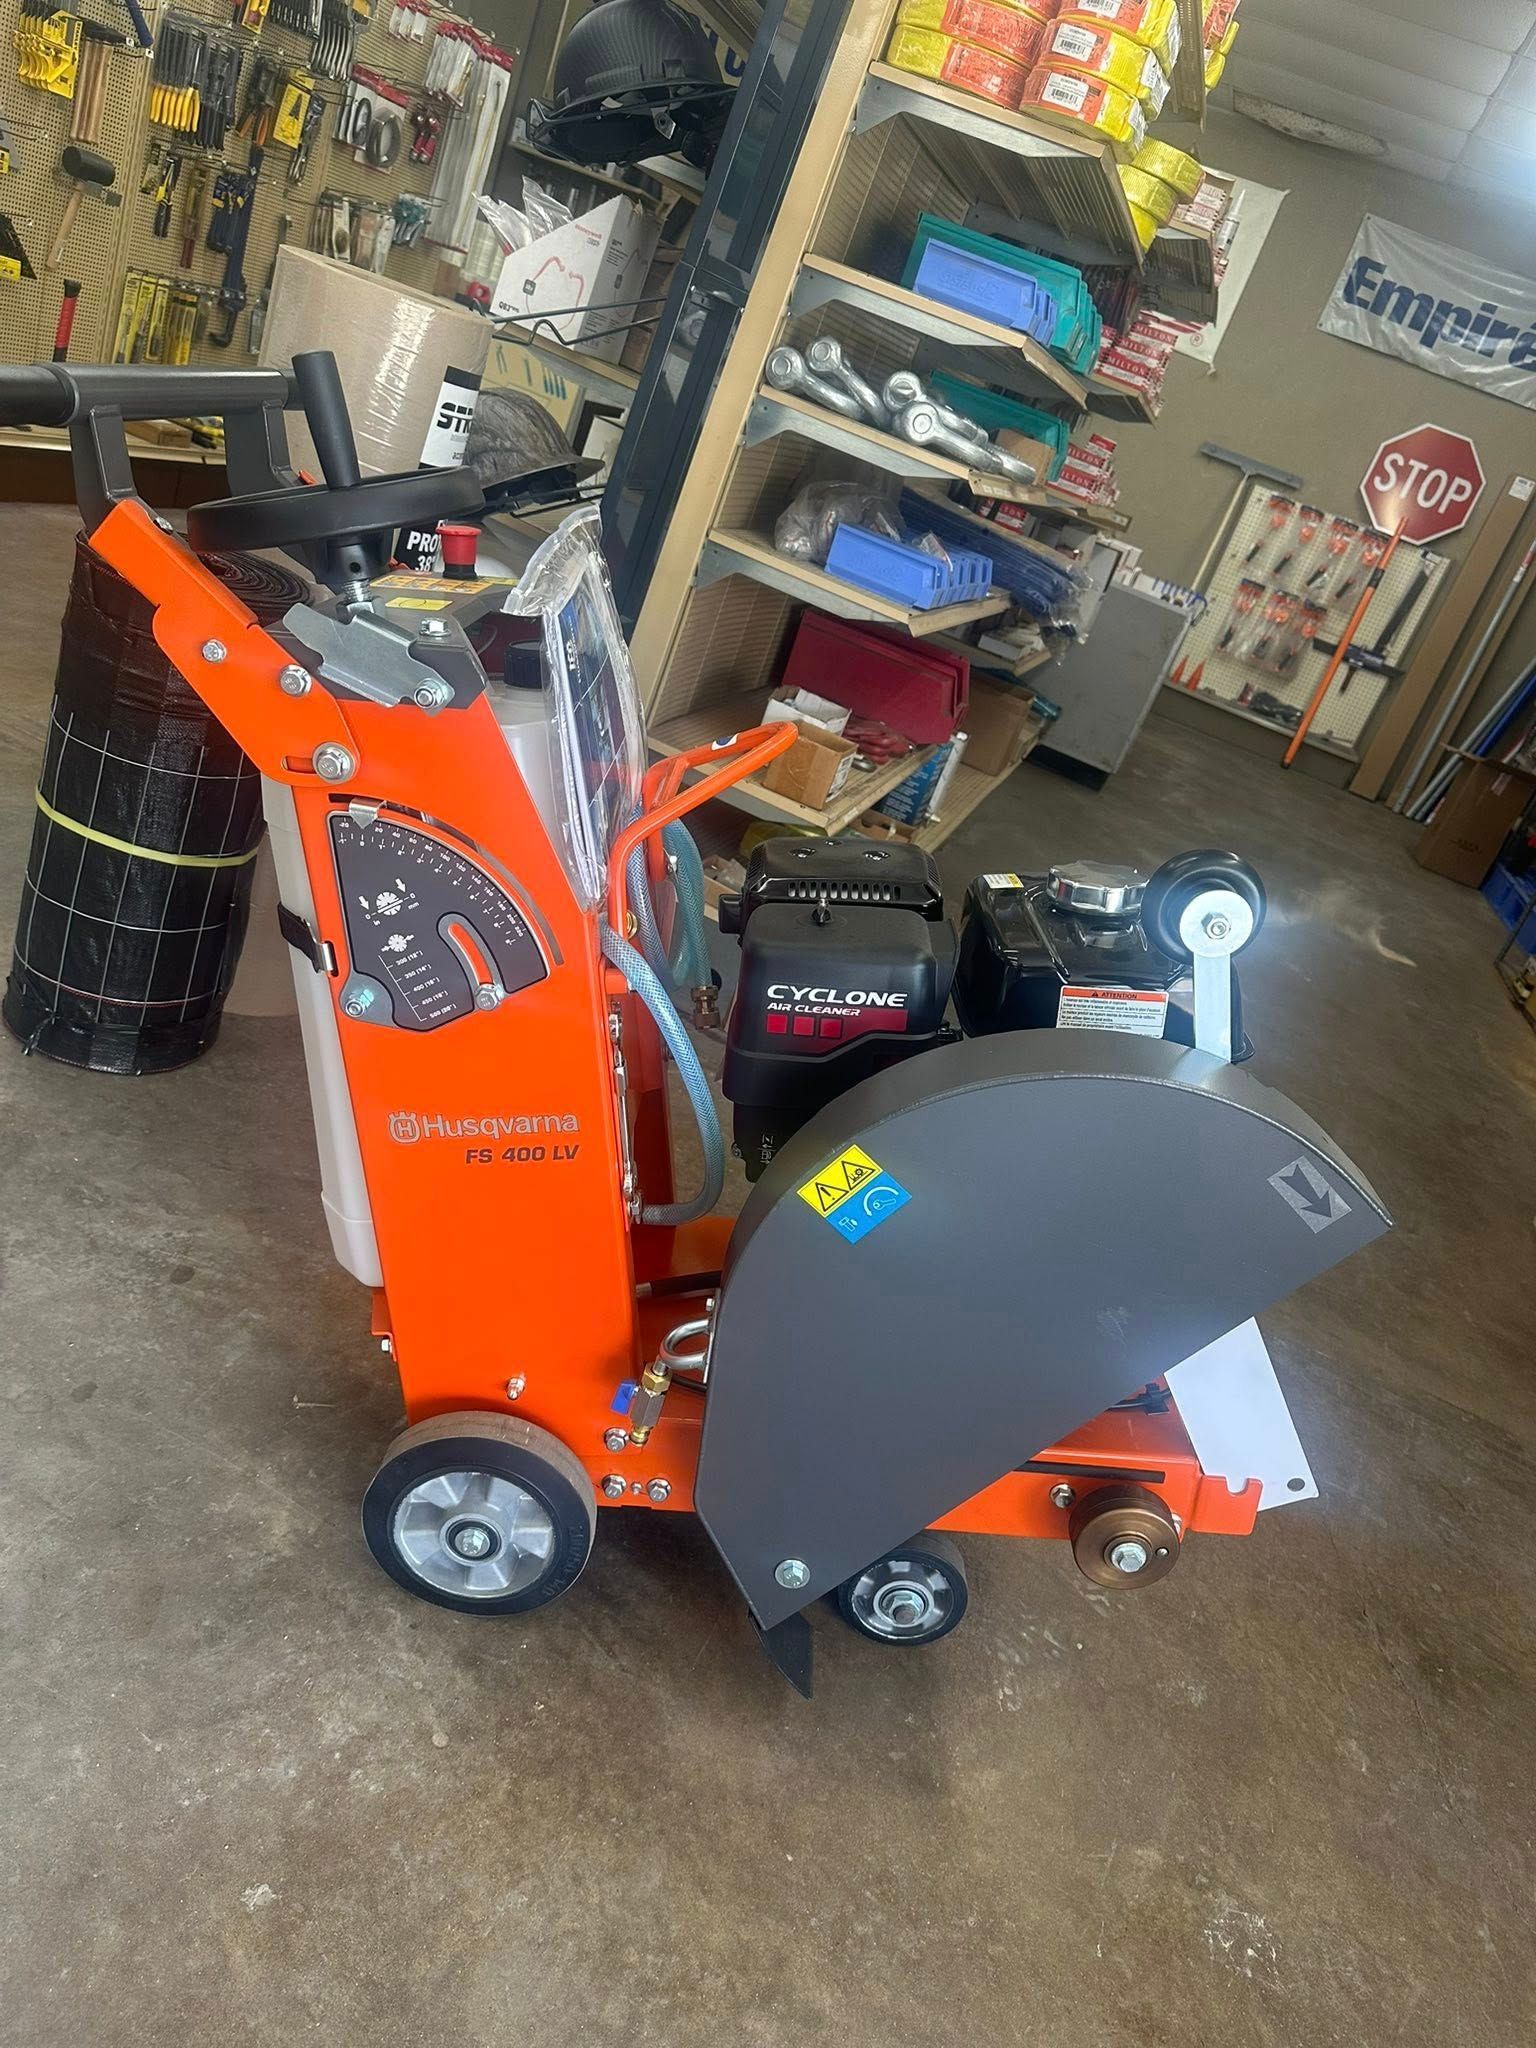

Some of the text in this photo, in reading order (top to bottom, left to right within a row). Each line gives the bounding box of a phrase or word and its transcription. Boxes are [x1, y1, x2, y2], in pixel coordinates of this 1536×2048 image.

[1342, 256, 1536, 372] Empire
[1136, 323, 1172, 343] MILTON
[1120, 338, 1158, 358] MILTON
[1108, 356, 1146, 376] MILTON
[1373, 452, 1473, 514] STOP
[767, 984, 908, 1007] CYCLONE
[1101, 991, 1138, 1000] ATTENTION
[767, 1002, 861, 1016] AIR CLEANER
[421, 1112, 580, 1140] Husqvarna
[465, 1144, 580, 1164] FS 400 LV
